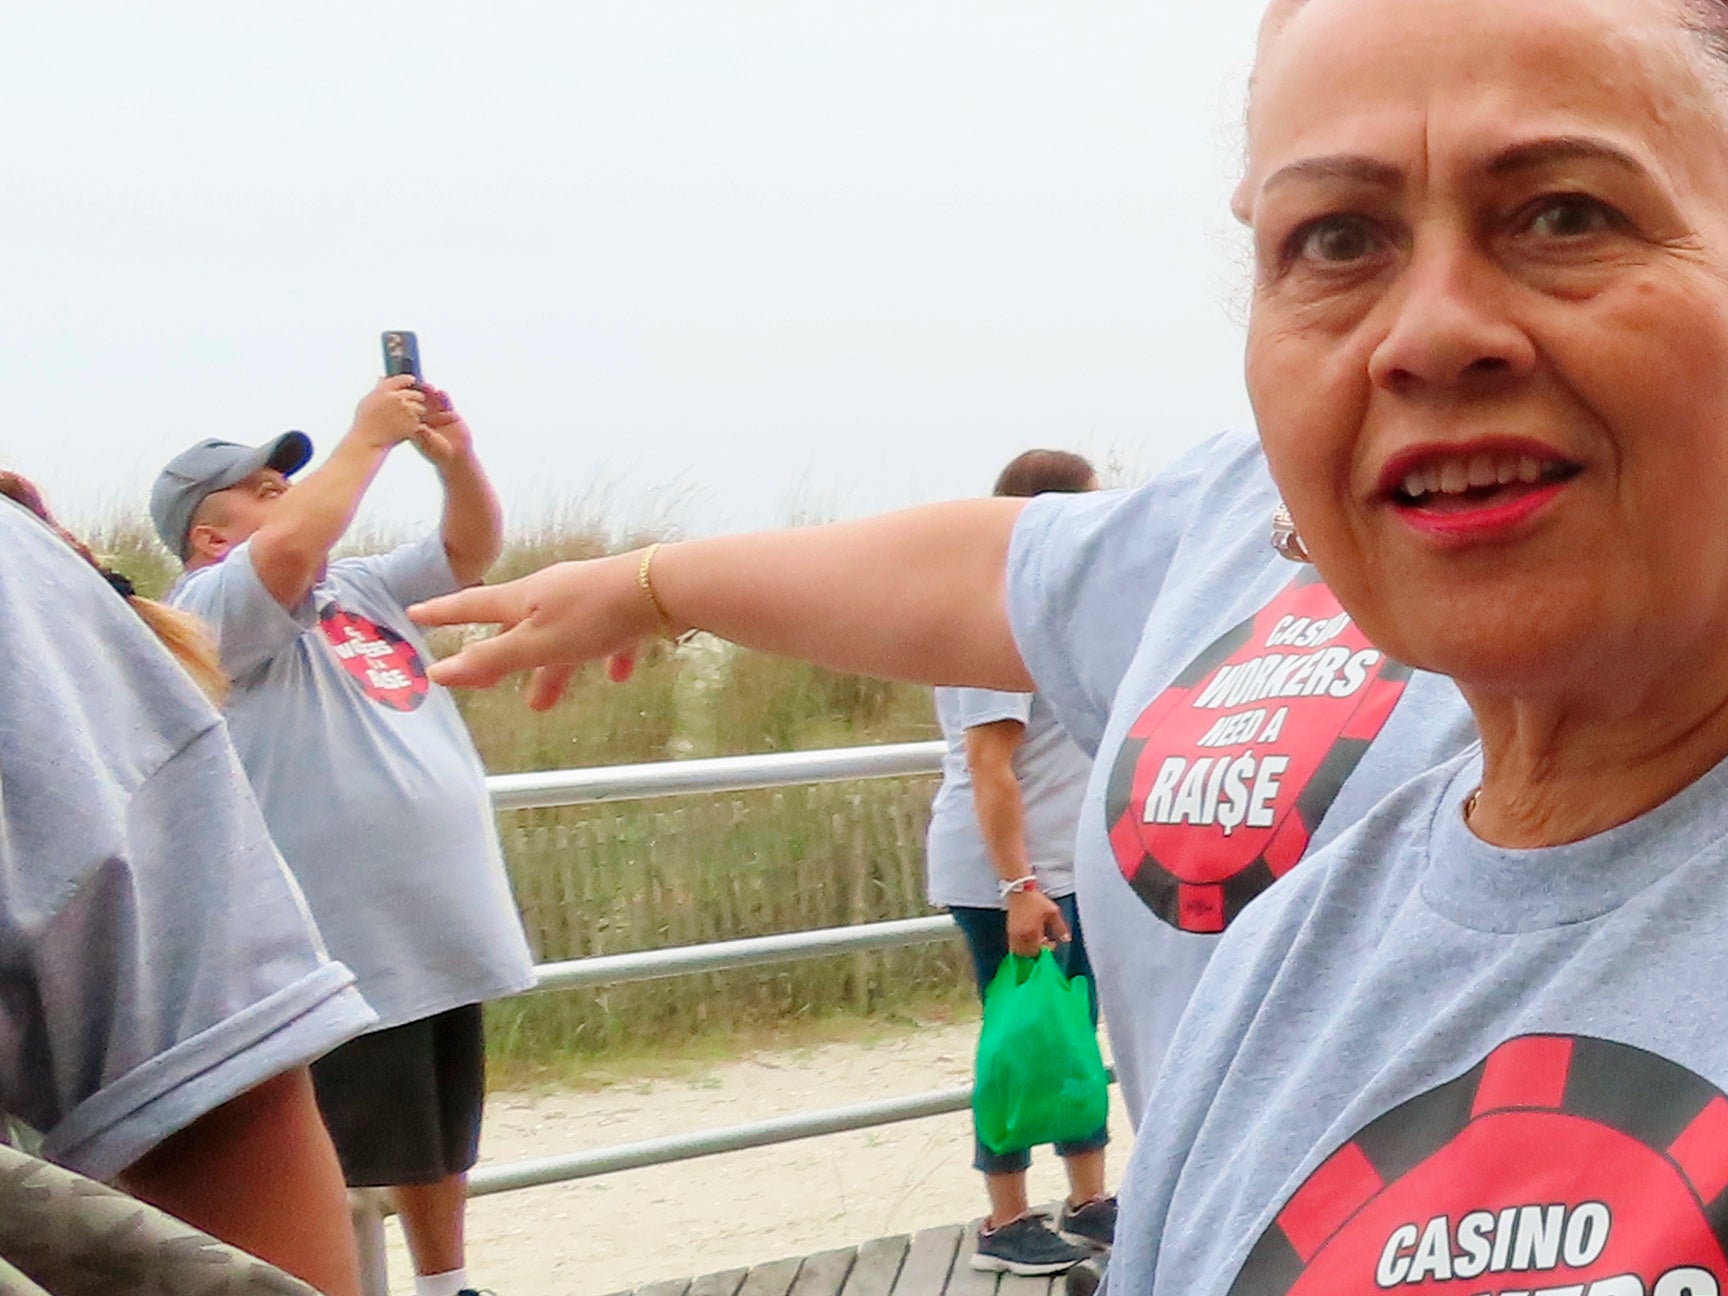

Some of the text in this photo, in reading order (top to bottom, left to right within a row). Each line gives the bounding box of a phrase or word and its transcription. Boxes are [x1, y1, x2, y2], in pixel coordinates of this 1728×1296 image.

[1193, 647, 1381, 709] WORKERS
[1197, 706, 1289, 748] NEED A
[1375, 1200, 1612, 1289] CASINO
